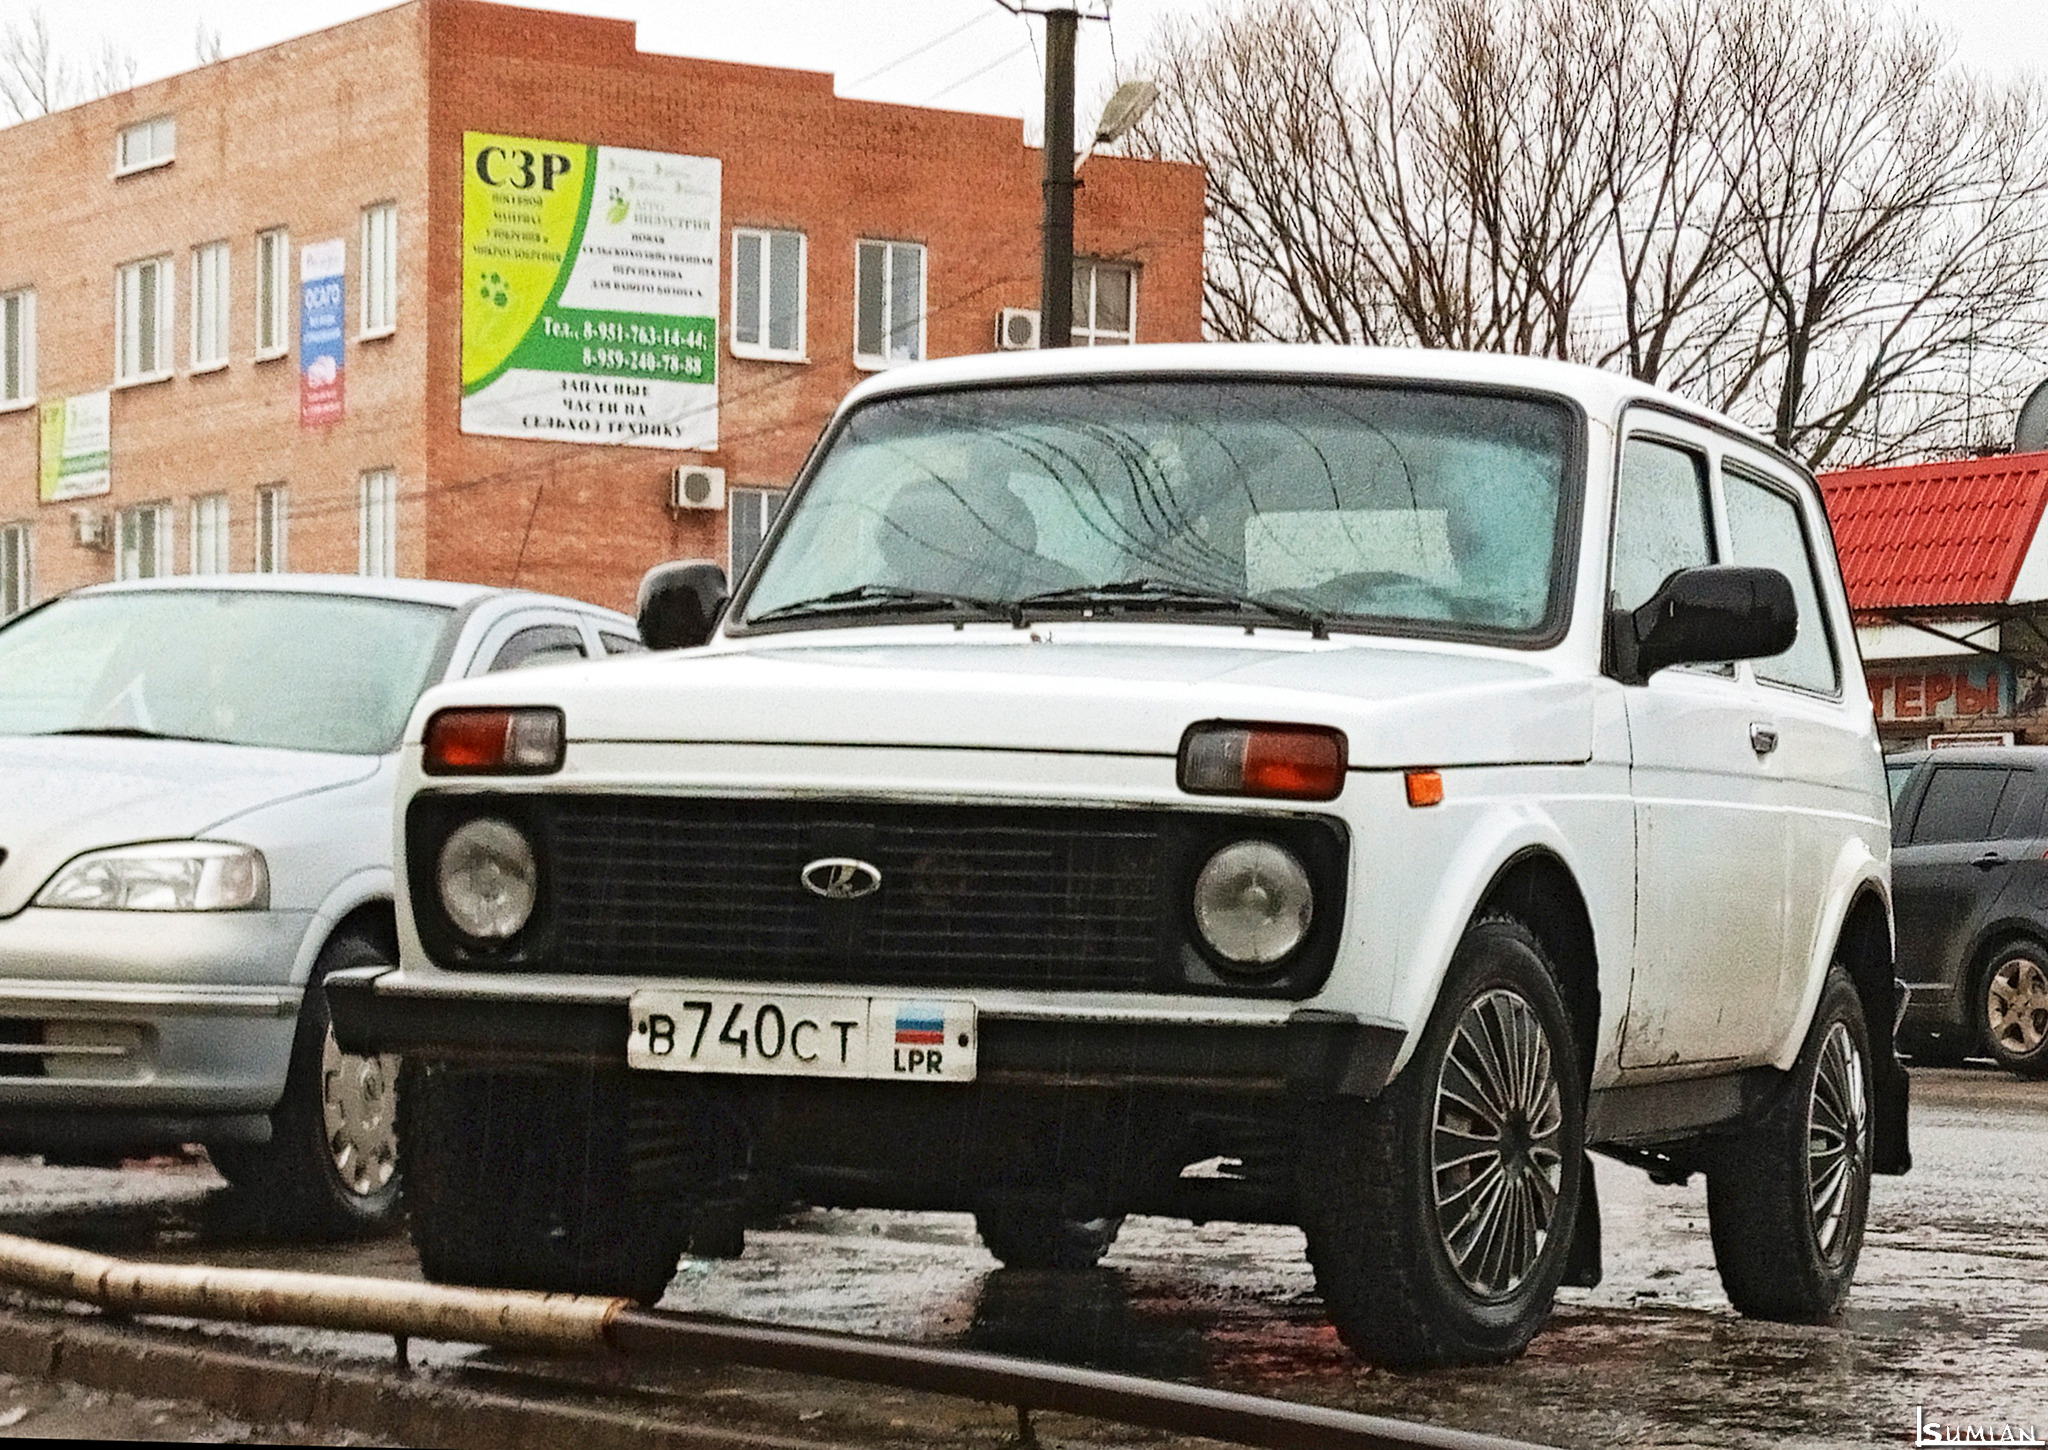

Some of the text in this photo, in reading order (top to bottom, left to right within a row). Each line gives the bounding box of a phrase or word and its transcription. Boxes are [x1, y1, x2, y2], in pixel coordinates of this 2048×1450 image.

[476, 146, 571, 191] СЗР
[561, 379, 650, 397] ЗАПАСНЫЕ
[562, 398, 647, 417] ЧАСТИ НА
[893, 1049, 944, 1075] LPR
